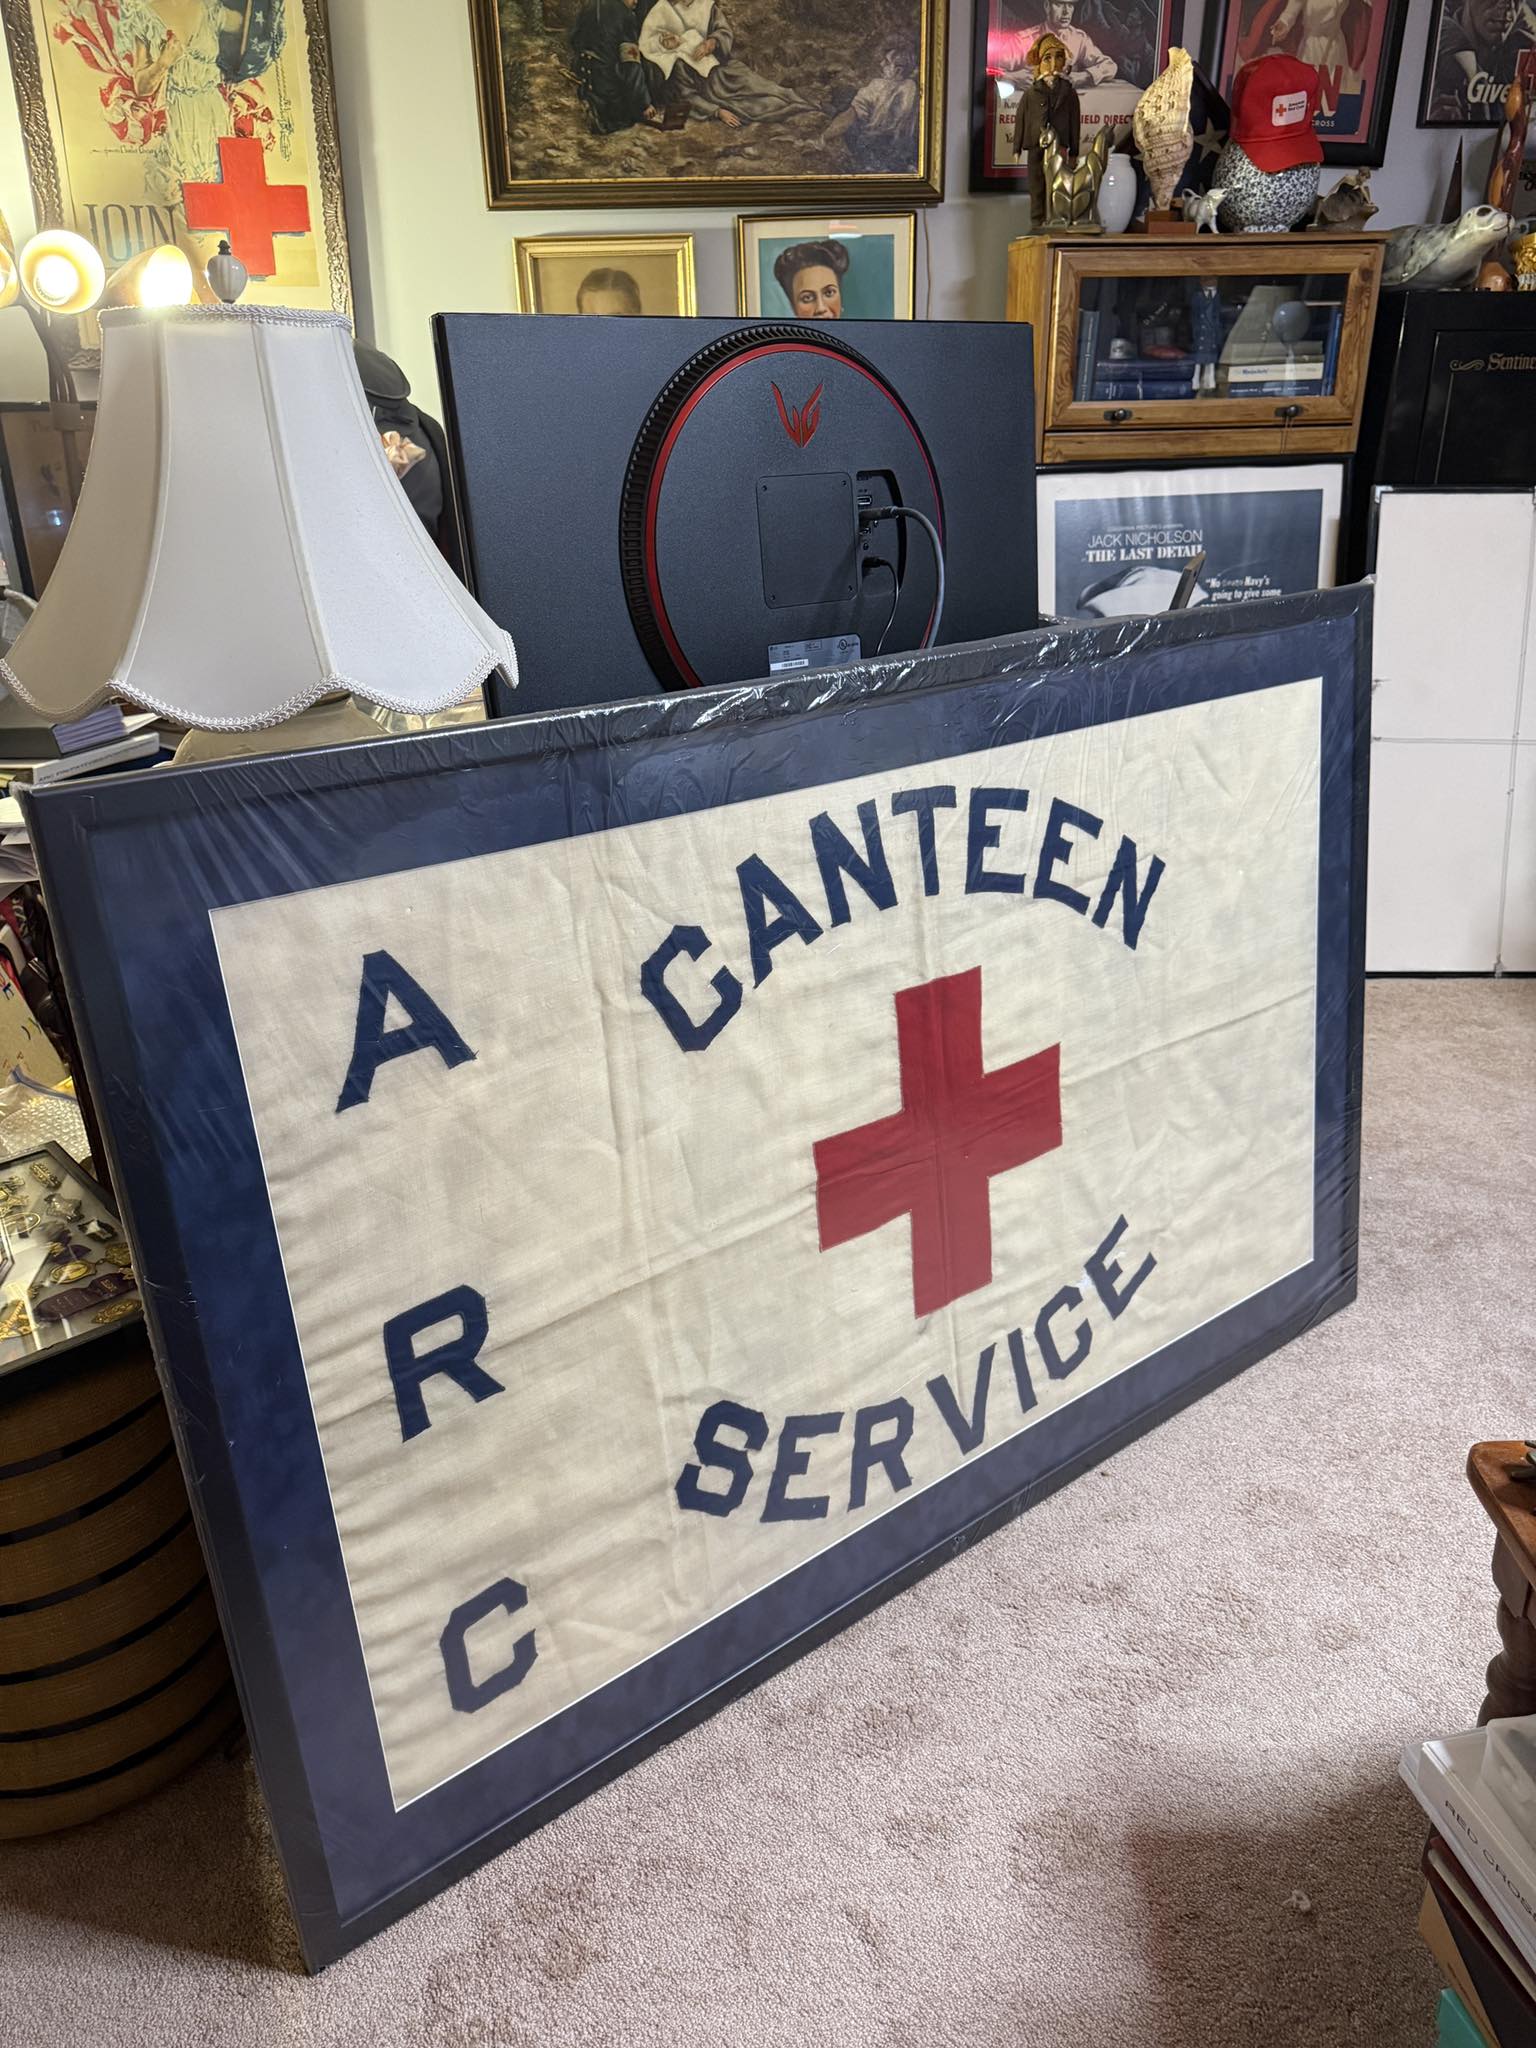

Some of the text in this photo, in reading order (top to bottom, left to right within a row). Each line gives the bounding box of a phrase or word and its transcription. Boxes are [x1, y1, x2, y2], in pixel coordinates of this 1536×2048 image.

[1467, 71, 1512, 103] Give
[999, 114, 1134, 124] RED IELD DIRECT
[83, 203, 178, 262] JOIN
[1487, 352, 1536, 372] Sentine
[1087, 529, 1203, 548] JACK NICHOLSON
[1086, 549, 1116, 563] THE
[1120, 547, 1154, 561] LAST
[1211, 588, 1282, 601] going to give some
[639, 785, 1166, 1053] CANTEEN
[675, 1213, 1157, 1523] SERVICE
[1445, 1800, 1479, 1845] RED
